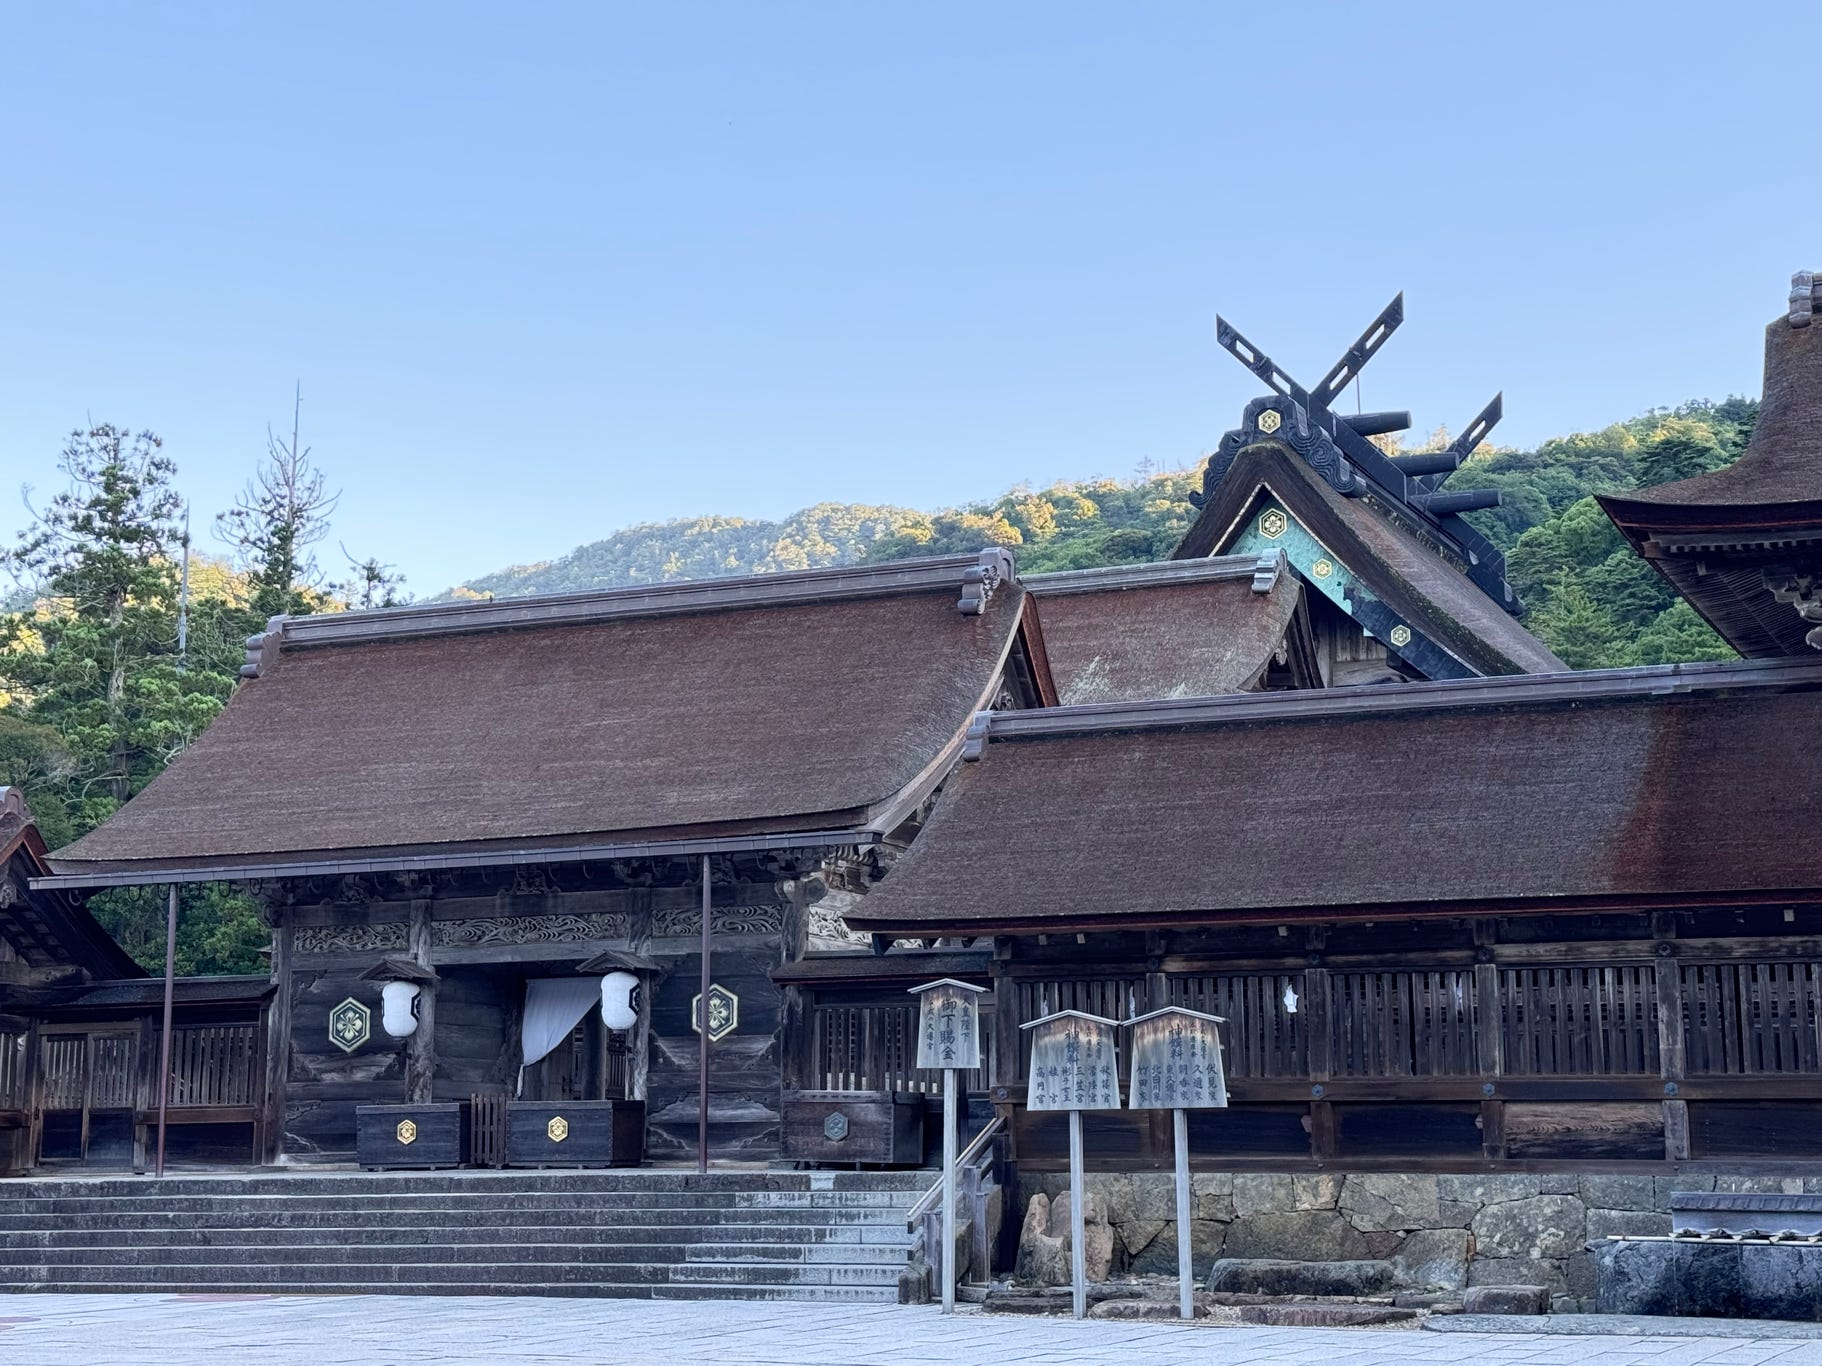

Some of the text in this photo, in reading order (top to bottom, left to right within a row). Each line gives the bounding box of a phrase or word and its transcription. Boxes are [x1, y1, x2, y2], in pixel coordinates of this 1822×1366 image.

[939, 998, 957, 1061] 御下賜金
[1036, 1066, 1045, 1104] 高円宮
[1075, 1066, 1085, 1104] 三笠宮
